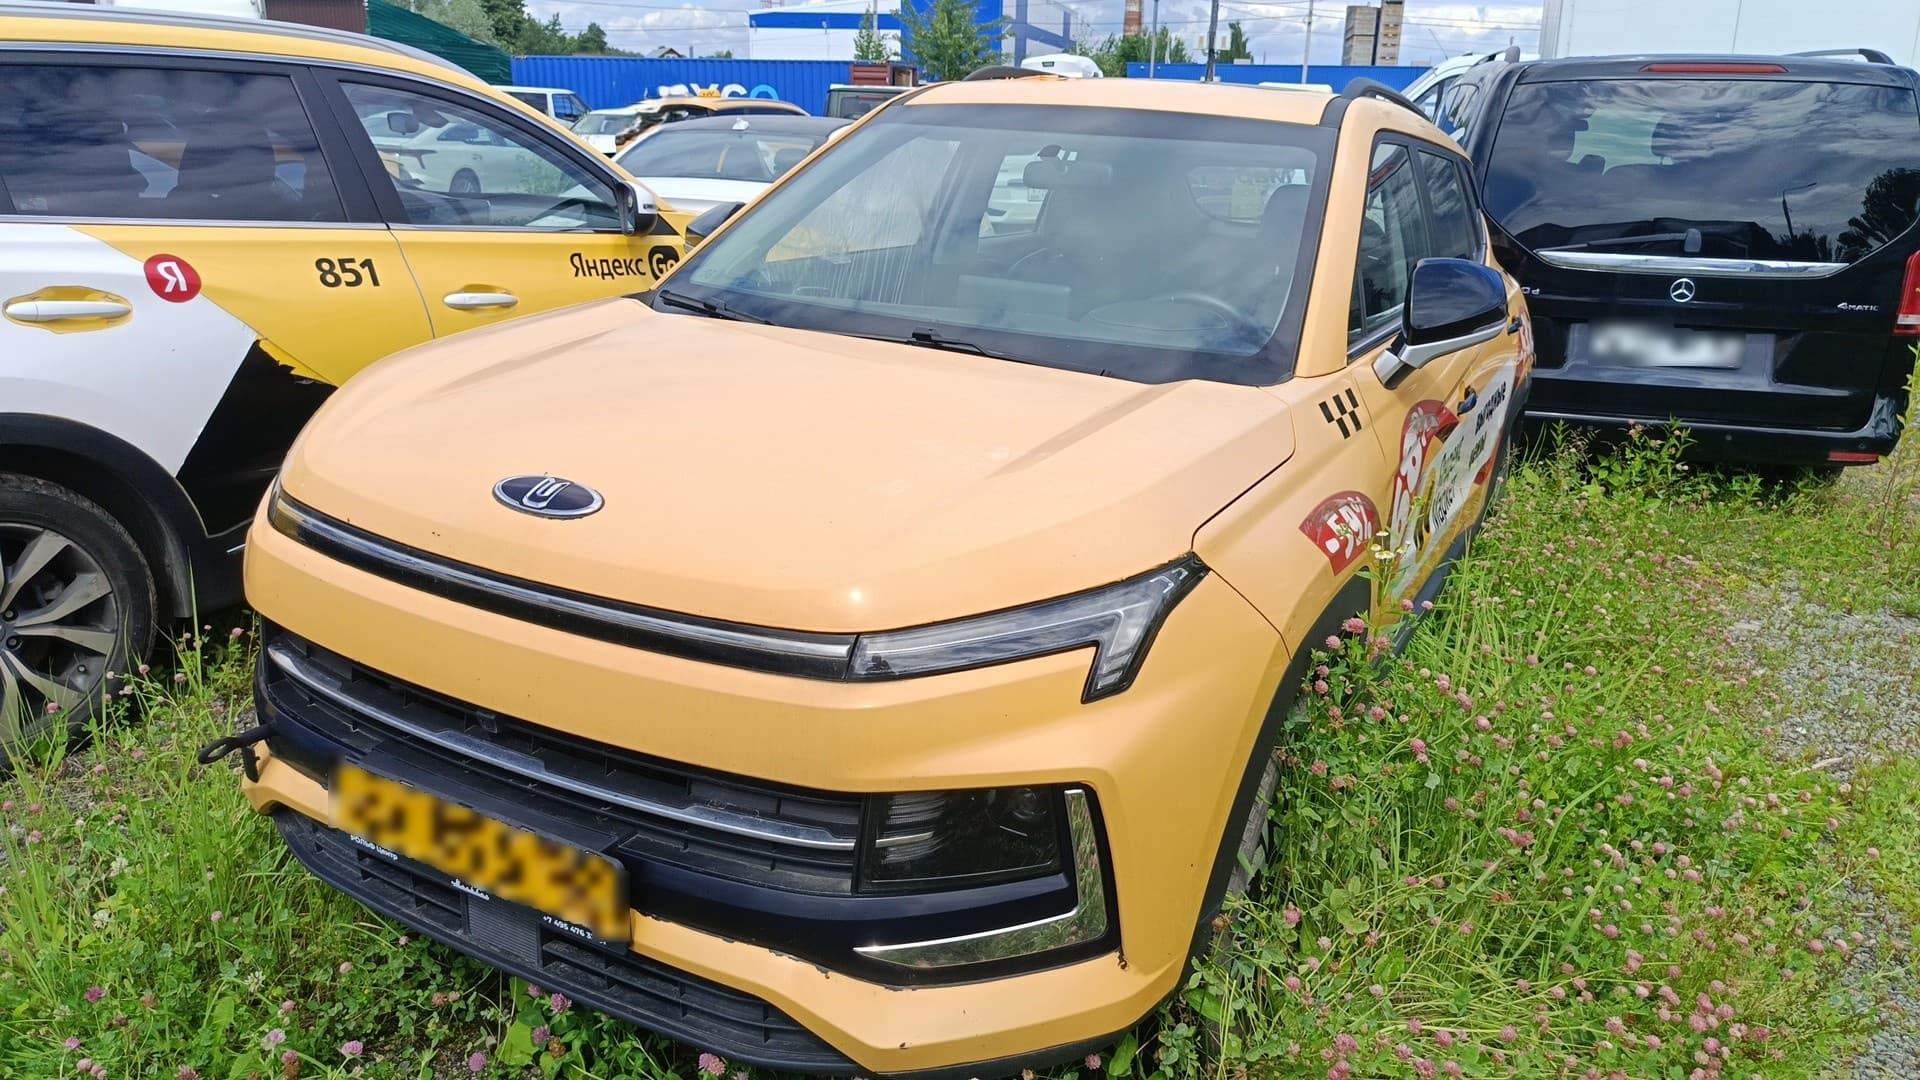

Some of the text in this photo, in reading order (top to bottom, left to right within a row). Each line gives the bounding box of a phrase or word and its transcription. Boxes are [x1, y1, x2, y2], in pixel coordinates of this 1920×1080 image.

[156, 261, 188, 293] Я
[315, 258, 381, 288] 851
[569, 252, 647, 281] Яндекс
[1837, 302, 1880, 312] 4MATIC
